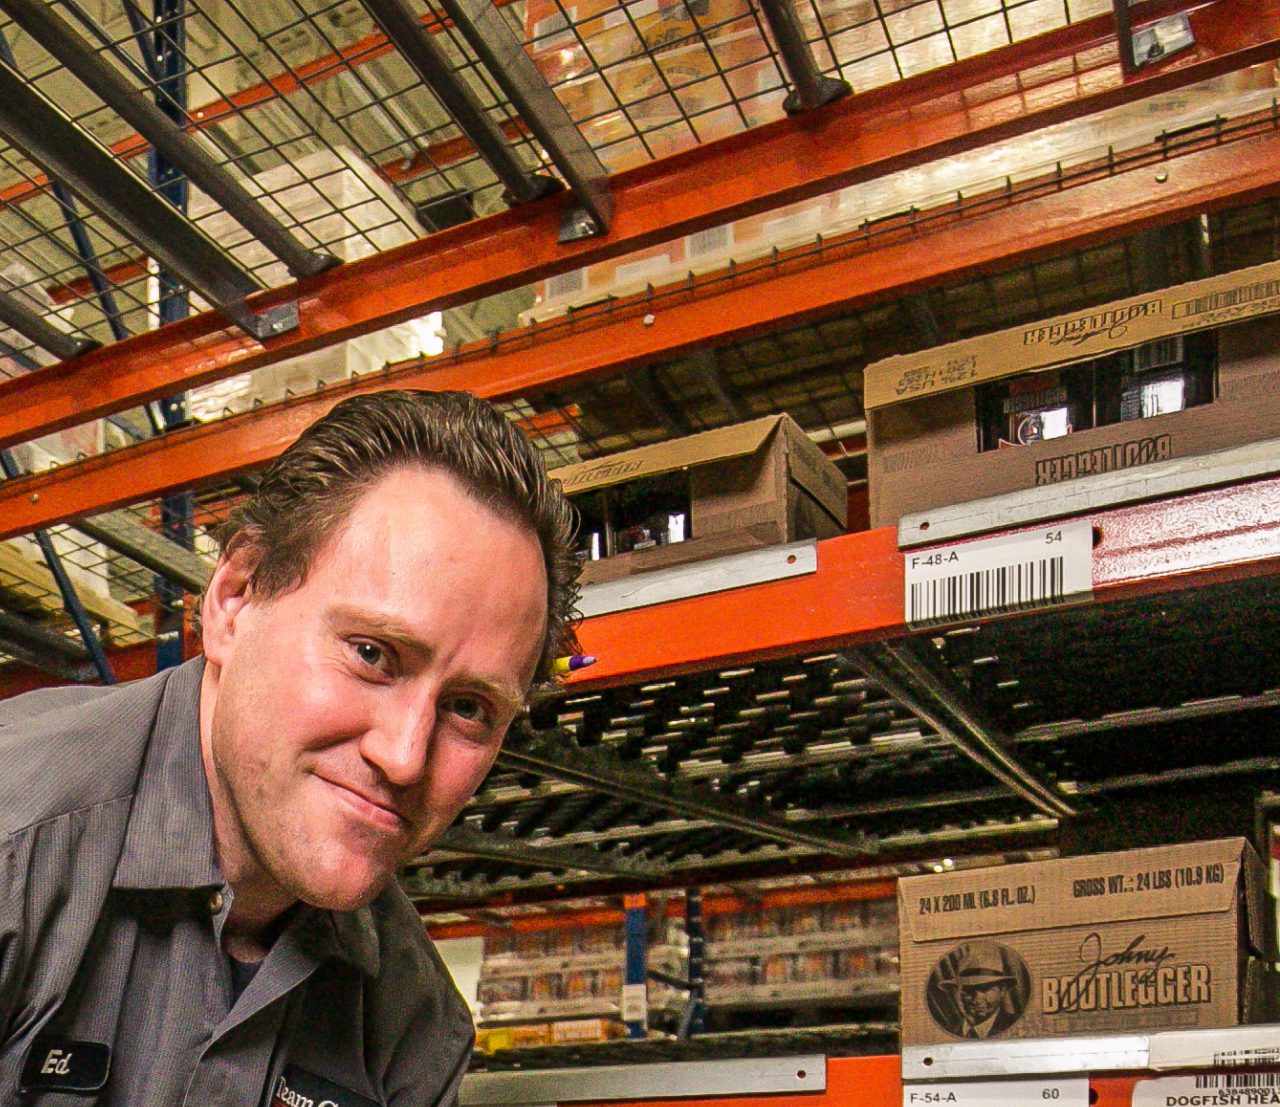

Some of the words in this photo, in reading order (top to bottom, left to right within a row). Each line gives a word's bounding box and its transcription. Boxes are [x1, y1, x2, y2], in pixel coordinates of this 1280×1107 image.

[1045, 530, 1063, 546] 54
[911, 551, 959, 570] F-48-A
[1073, 877, 1106, 898] GROSS
[1137, 872, 1150, 891] 24
[1152, 869, 1172, 890] LBS
[1175, 865, 1203, 889] (10.9
[1206, 862, 1225, 884] KG)
[920, 897, 932, 915] 24
[934, 895, 941, 914] X
[942, 893, 961, 912] 200
[963, 891, 977, 910] ML
[1041, 964, 1212, 1015] BOOTLEGGER
[39, 1049, 72, 1075] Ed
[909, 1091, 958, 1105] F-54-A
[1042, 1088, 1060, 1101] 60
[1166, 1095, 1241, 1107] DOGFISH
[1247, 1093, 1280, 1106] HEA
